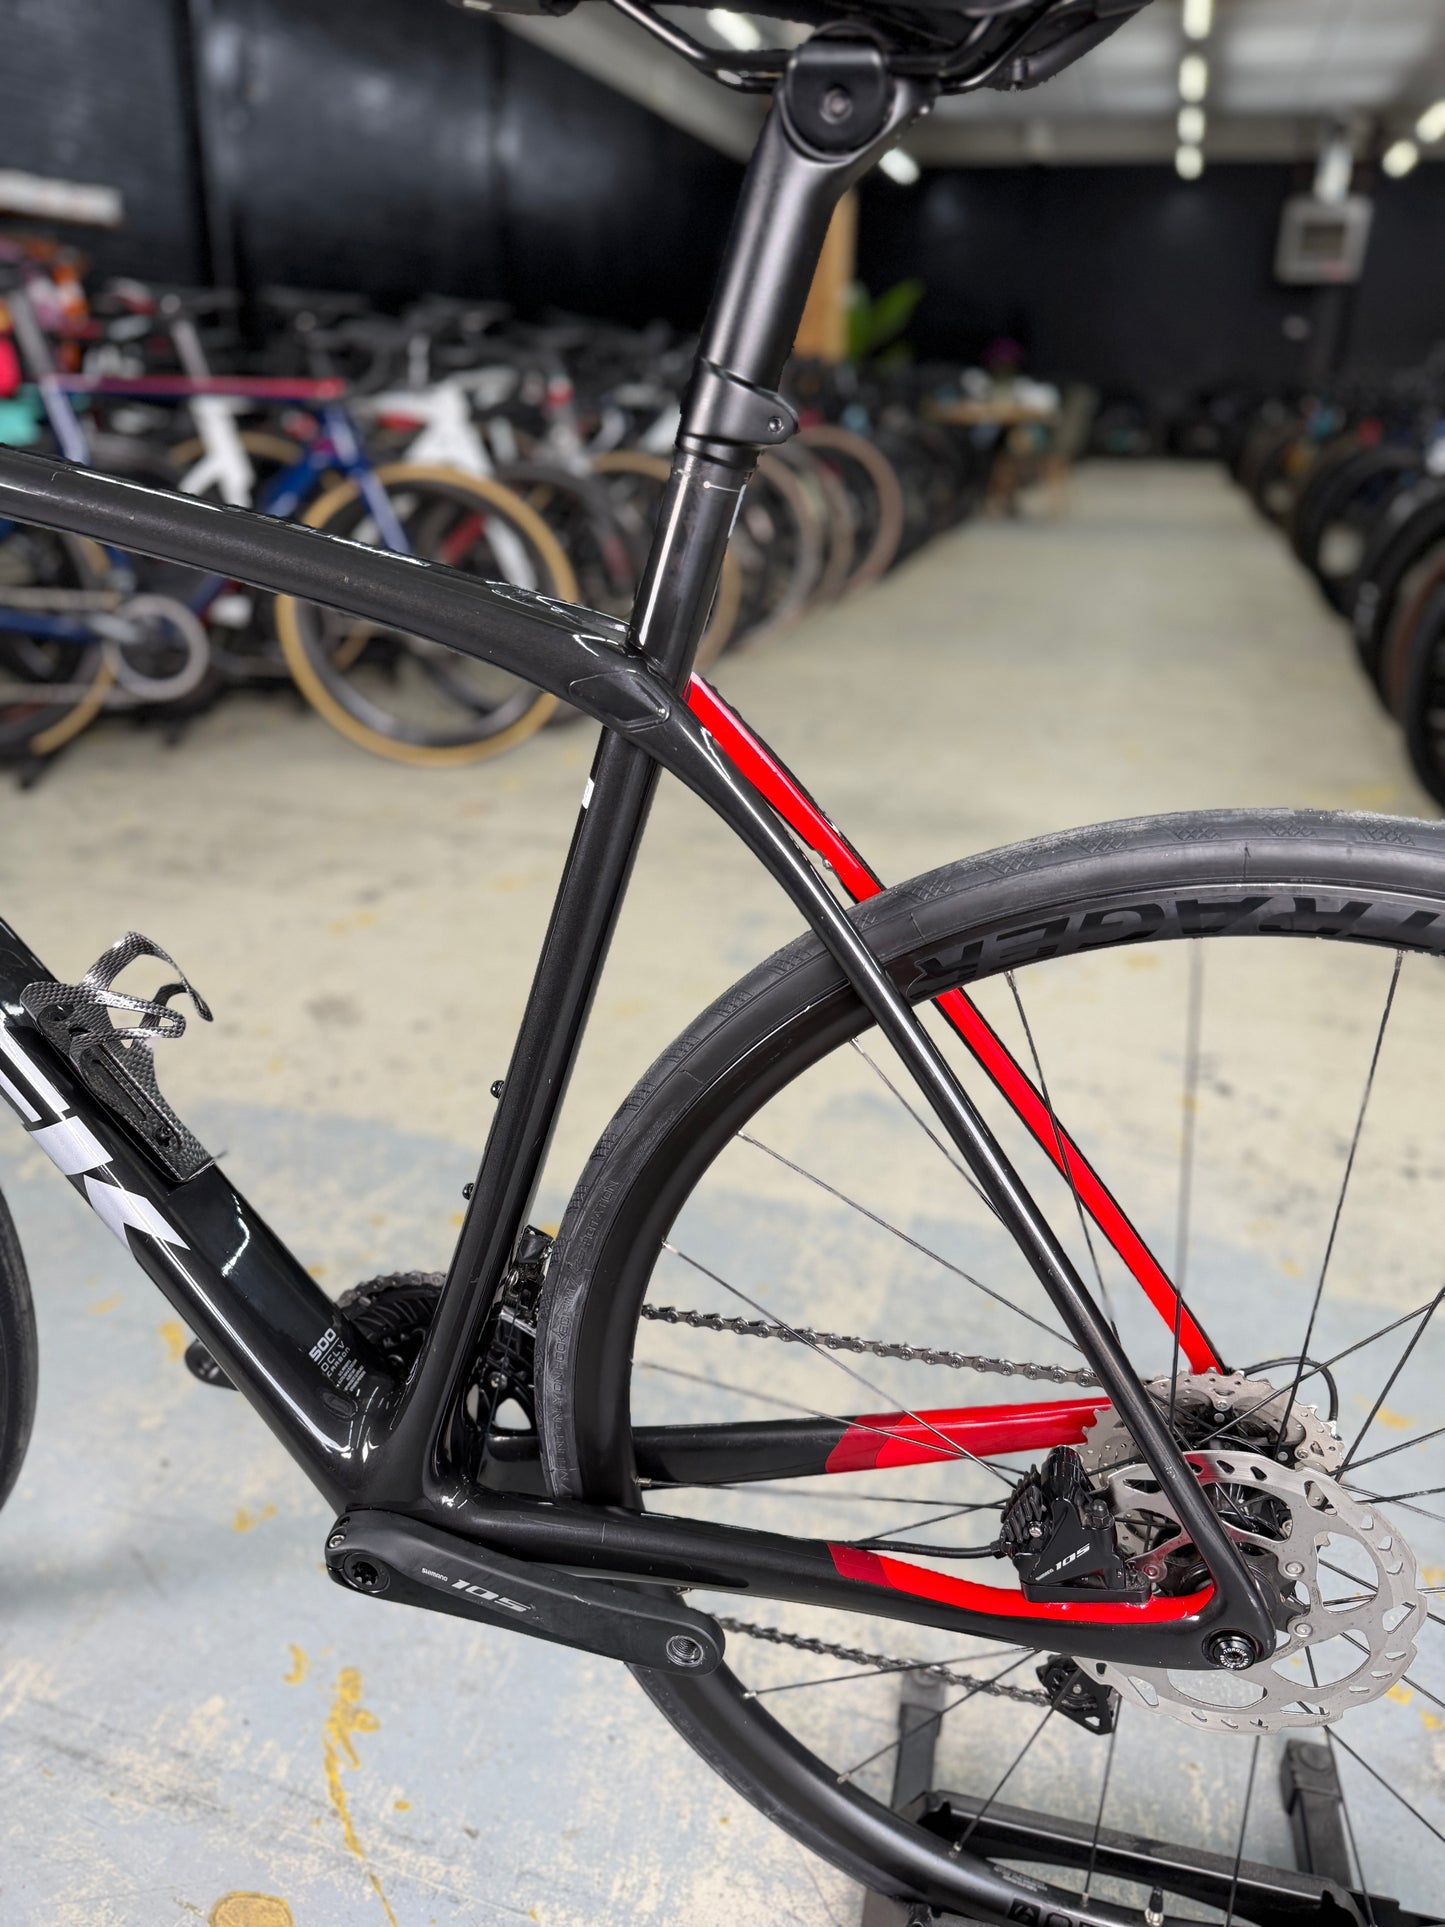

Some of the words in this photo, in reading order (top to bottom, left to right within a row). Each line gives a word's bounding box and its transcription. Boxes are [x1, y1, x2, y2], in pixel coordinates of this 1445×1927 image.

[308, 1327, 337, 1362] 500
[320, 1341, 345, 1372] OCLV
[1055, 1543, 1090, 1571] 105
[451, 1579, 532, 1613] 105
